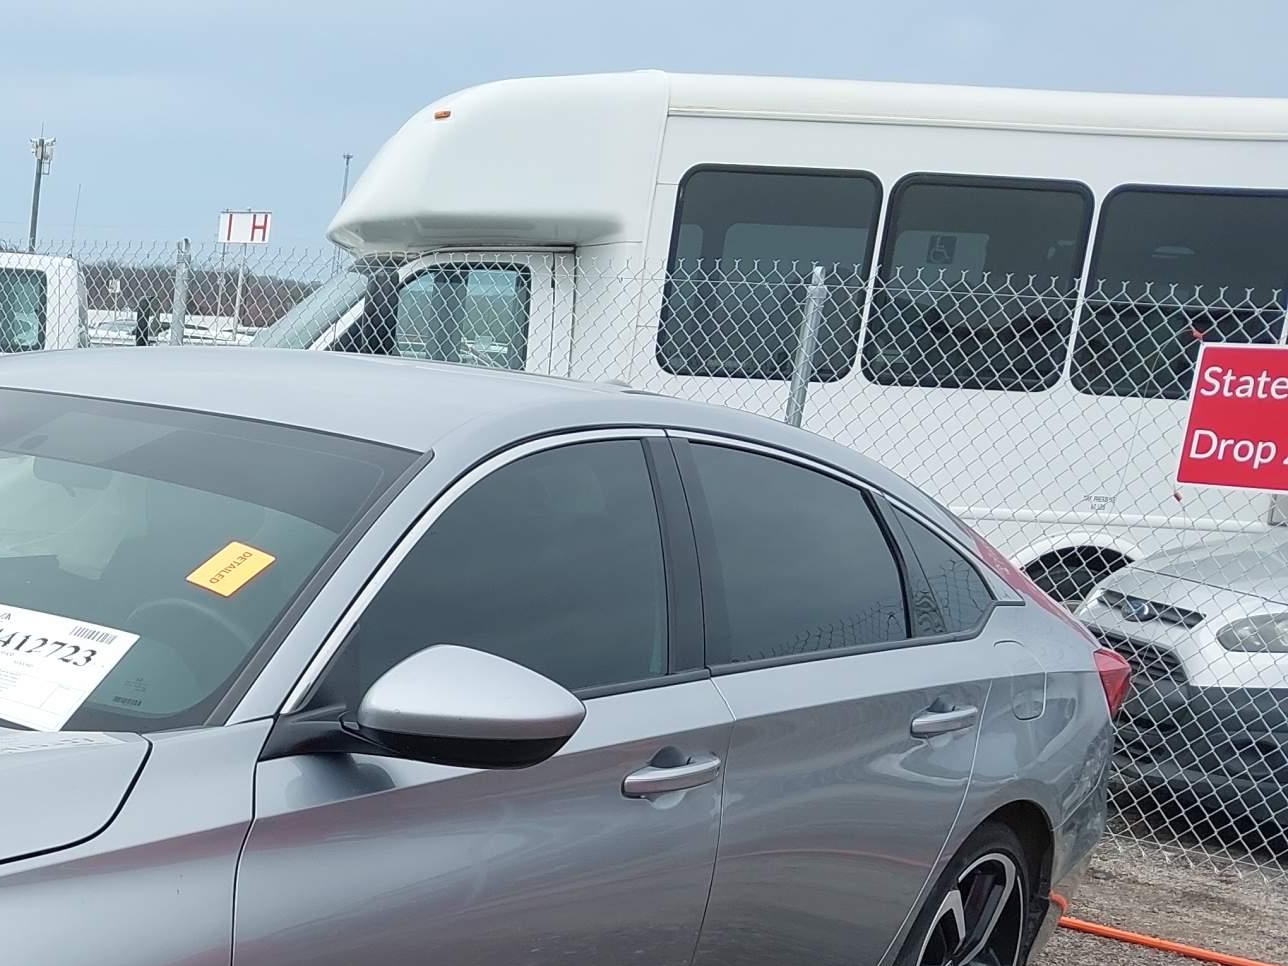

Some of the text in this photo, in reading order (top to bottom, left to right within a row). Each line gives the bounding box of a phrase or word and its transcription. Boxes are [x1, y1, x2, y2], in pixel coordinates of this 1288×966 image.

[250, 213, 269, 242] H
[1200, 365, 1288, 400] State
[1189, 428, 1278, 470] Drop
[208, 551, 253, 584] DETAILED
